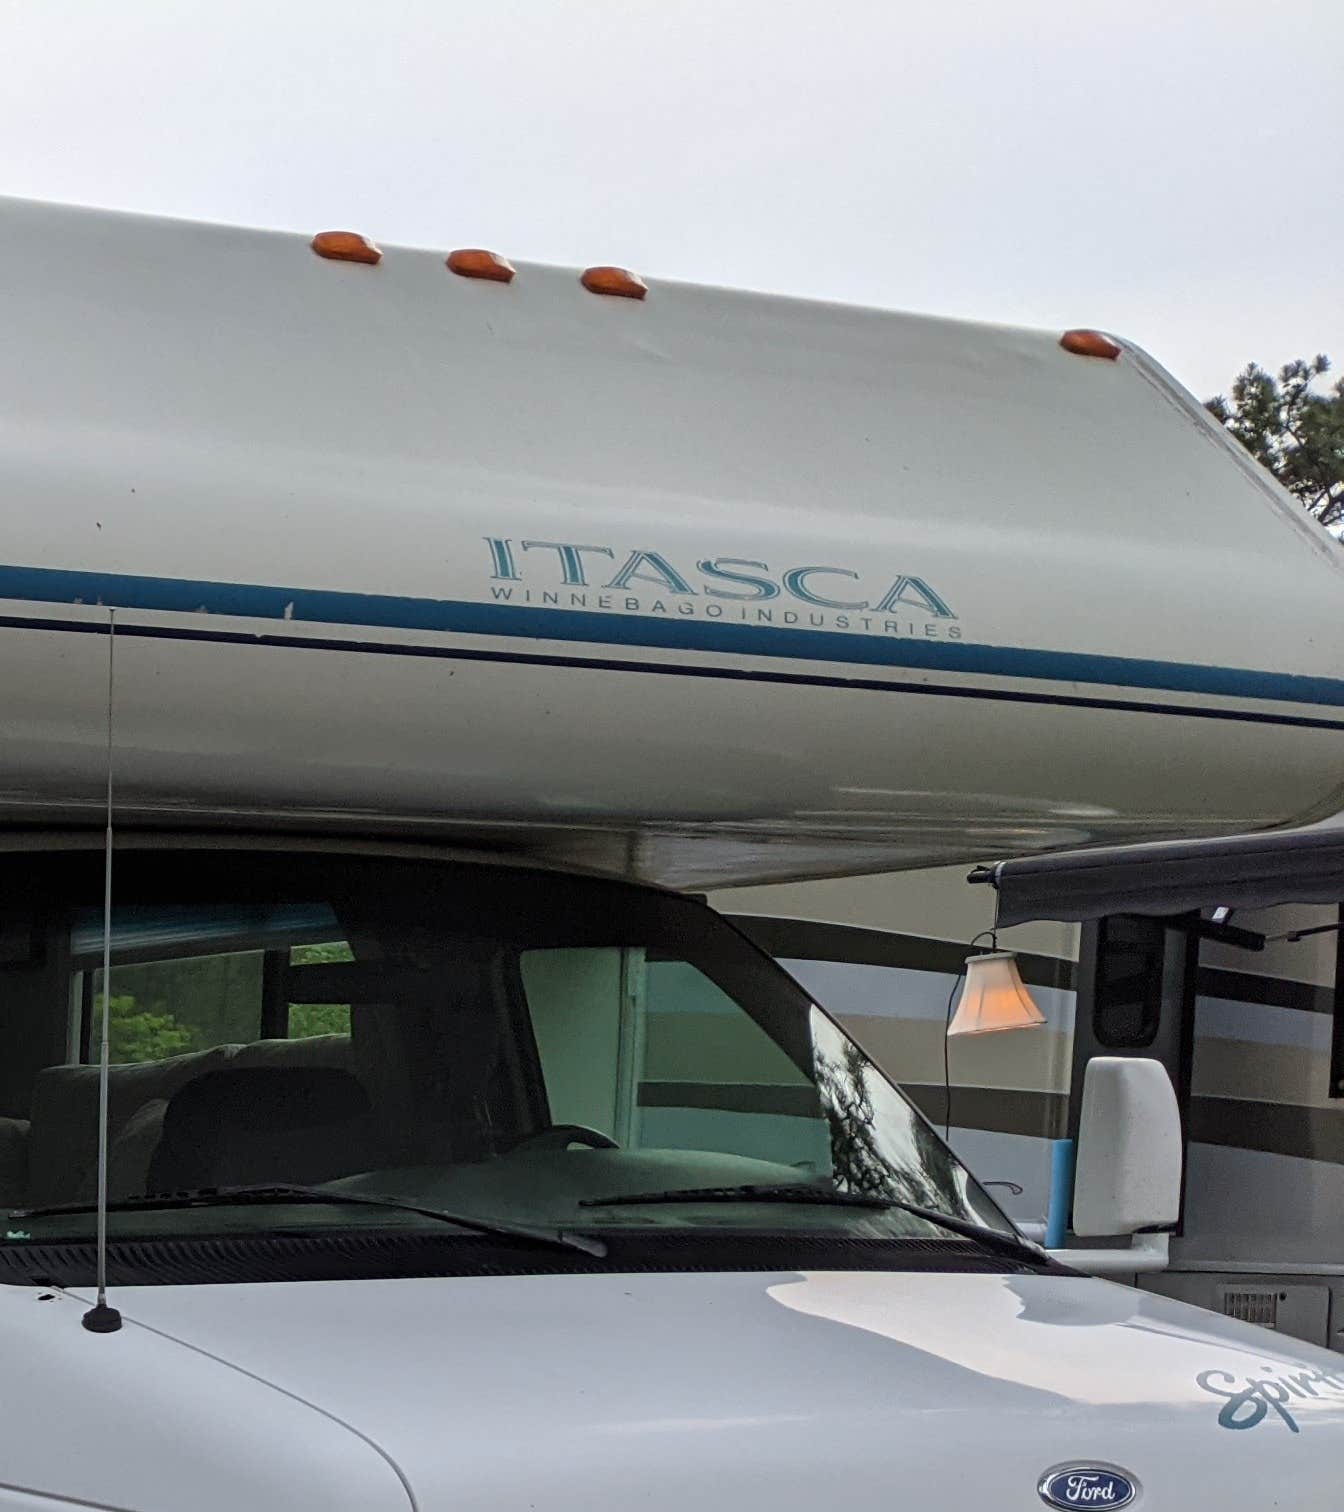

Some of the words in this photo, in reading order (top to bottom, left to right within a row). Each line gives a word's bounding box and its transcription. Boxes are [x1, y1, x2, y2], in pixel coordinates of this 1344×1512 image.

[482, 536, 959, 620] ITASCA
[491, 587, 722, 618] WINNEBAGO
[742, 607, 962, 639] INDUSTRIES
[1065, 1475, 1116, 1501] Ford
